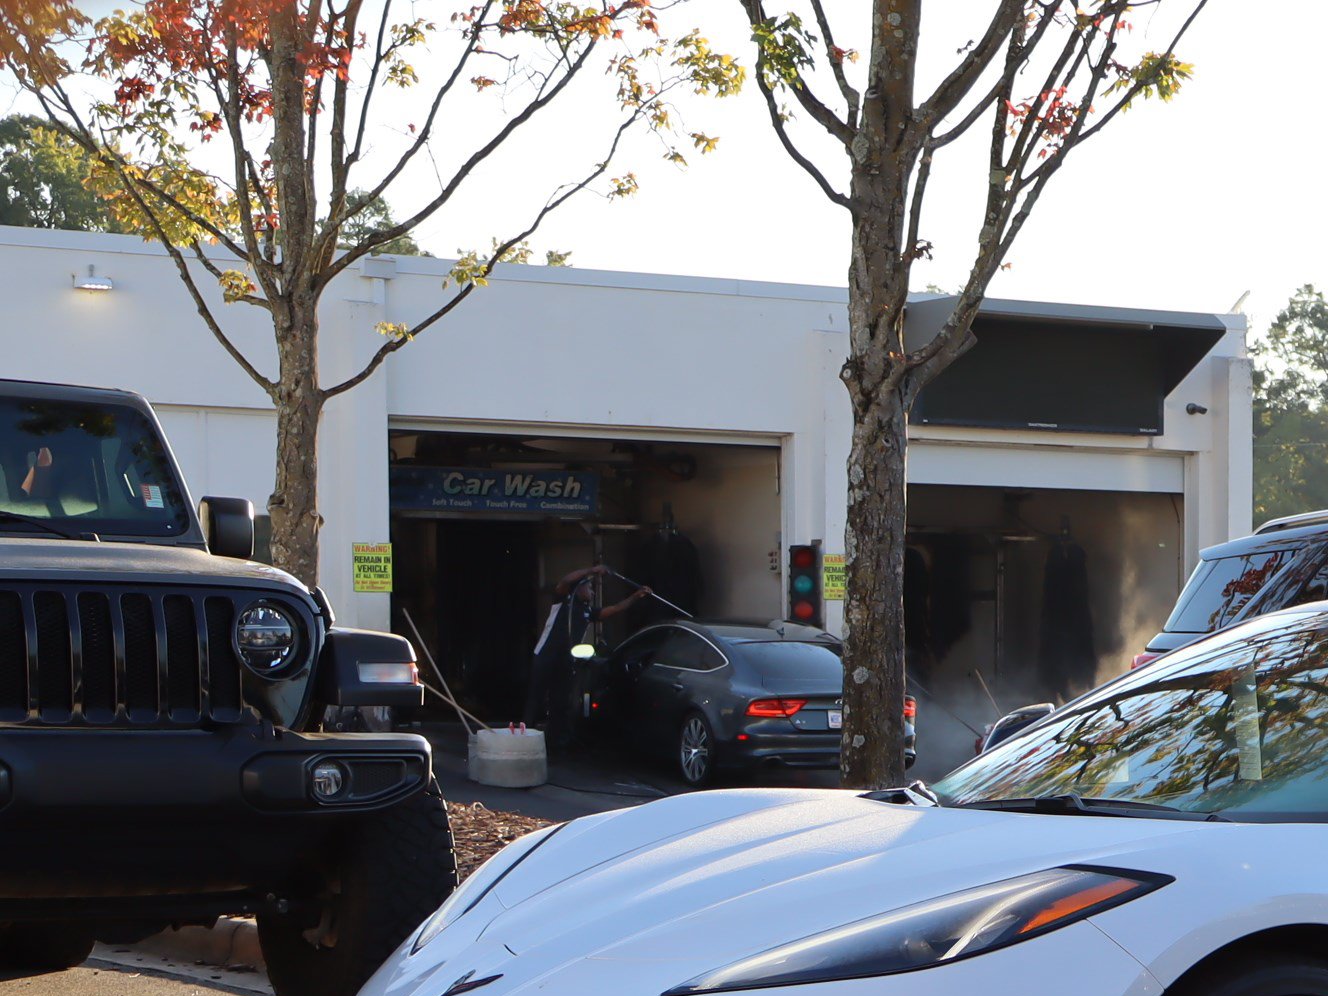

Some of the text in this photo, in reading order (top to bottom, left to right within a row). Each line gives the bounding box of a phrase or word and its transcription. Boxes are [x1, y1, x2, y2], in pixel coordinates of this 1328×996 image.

[443, 472, 582, 499] Car Wash
[448, 500, 472, 508] Touch
[485, 500, 527, 509] Touch Free
[540, 501, 589, 511] Combination
[354, 556, 391, 564] REMAIN IN
[357, 565, 388, 573] VEHICLE
